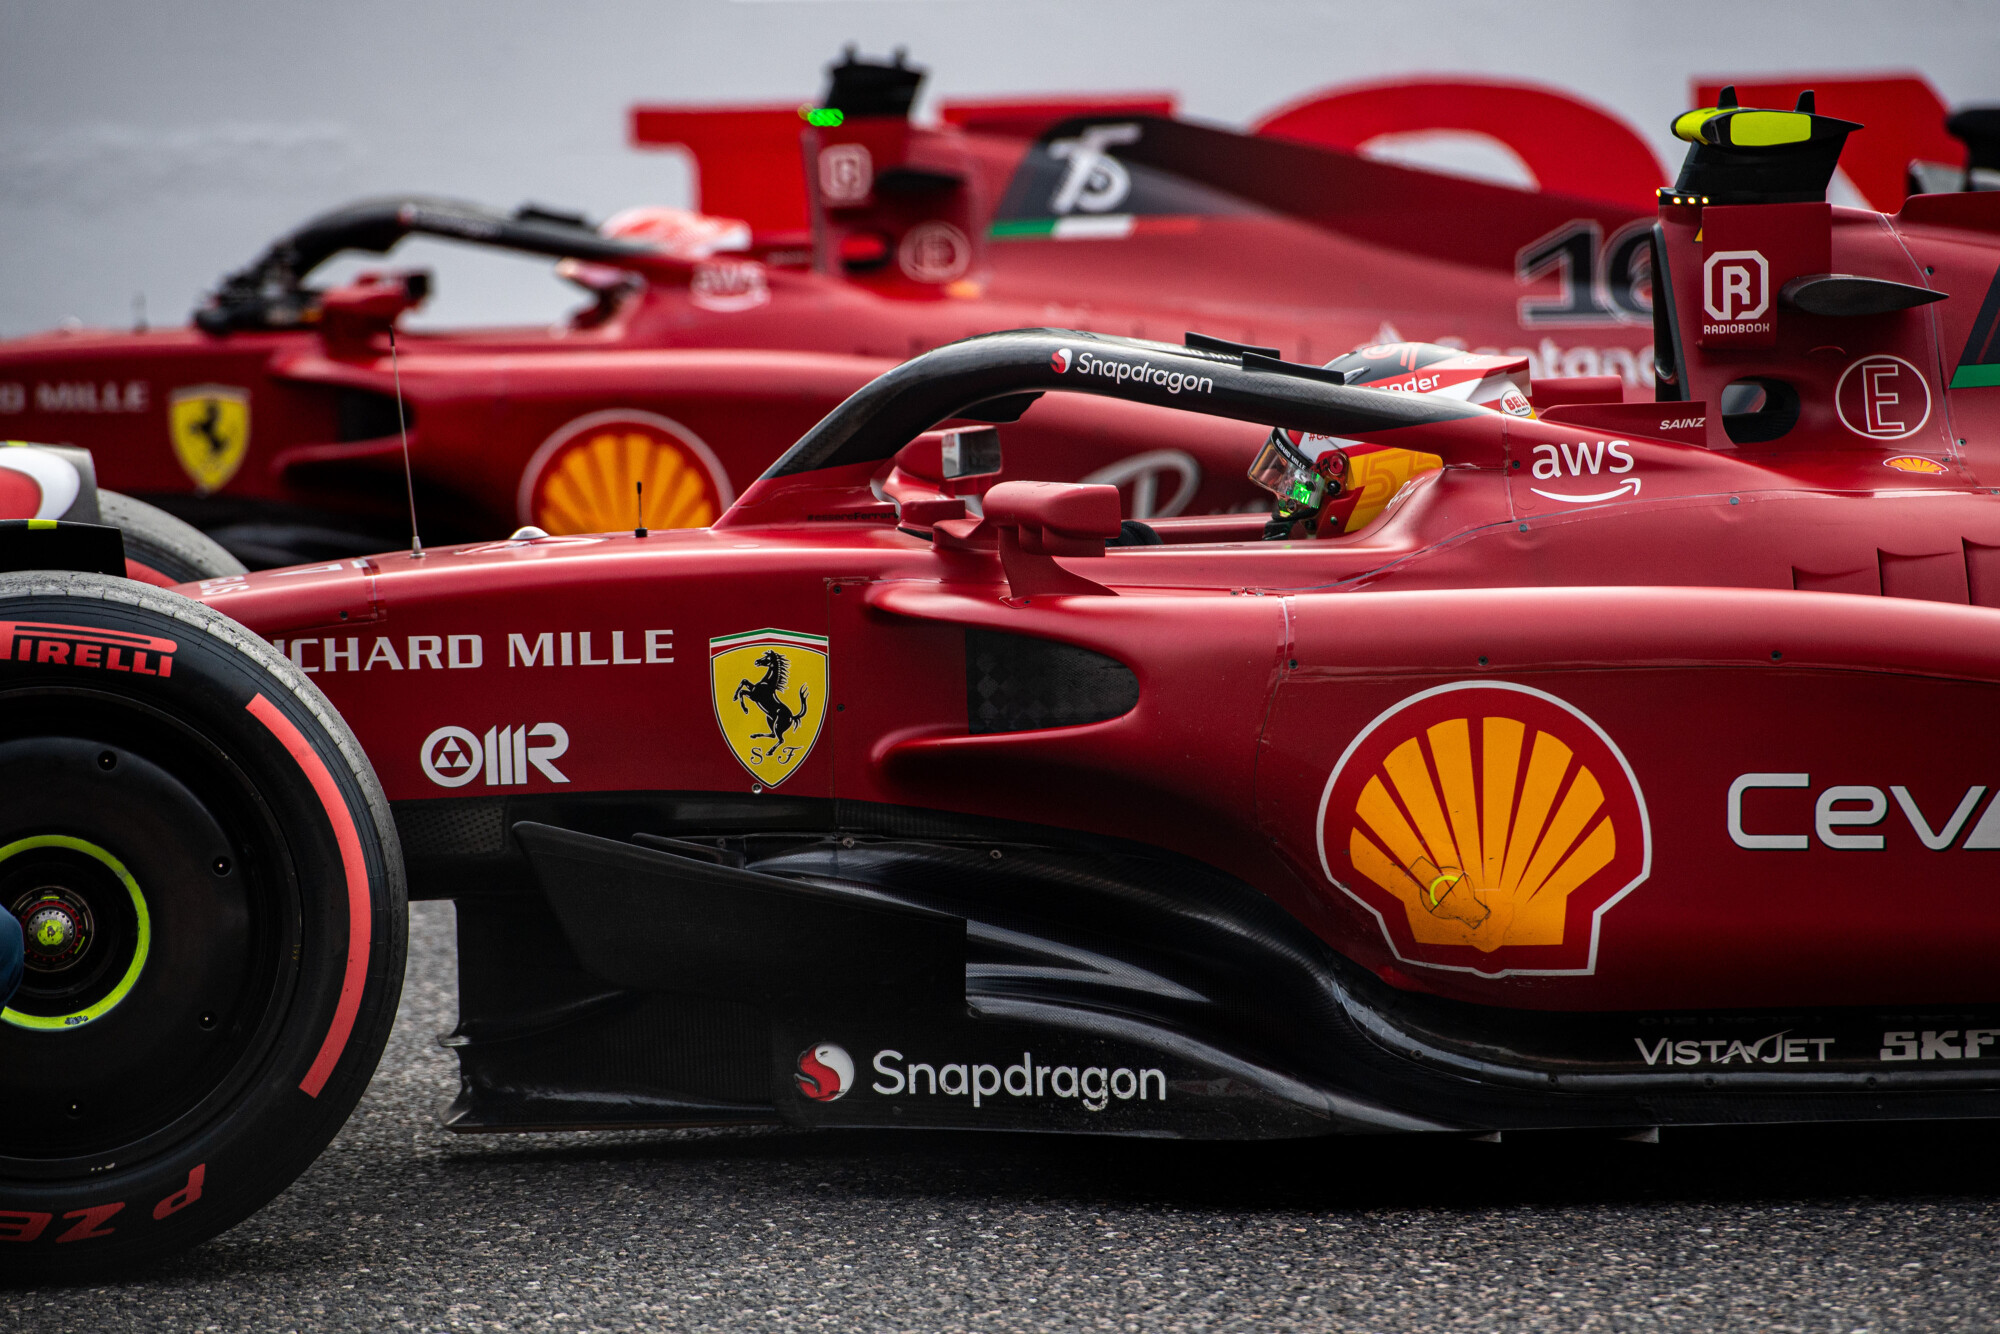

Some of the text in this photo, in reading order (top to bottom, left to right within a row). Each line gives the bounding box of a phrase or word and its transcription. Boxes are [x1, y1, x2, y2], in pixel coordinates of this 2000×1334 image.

[1703, 322, 1770, 335] RADIOBOOK
[1076, 352, 1213, 395] Snapdragon
[1366, 373, 1441, 395] nder
[1504, 392, 1529, 411] BELL
[1862, 364, 1906, 433] E
[1659, 416, 1706, 431] SAINZ
[1531, 440, 1635, 480] aws
[508, 629, 675, 667] MILLE
[1879, 1029, 2000, 1062] SKF
[872, 1049, 1167, 1112] Snapdragon
